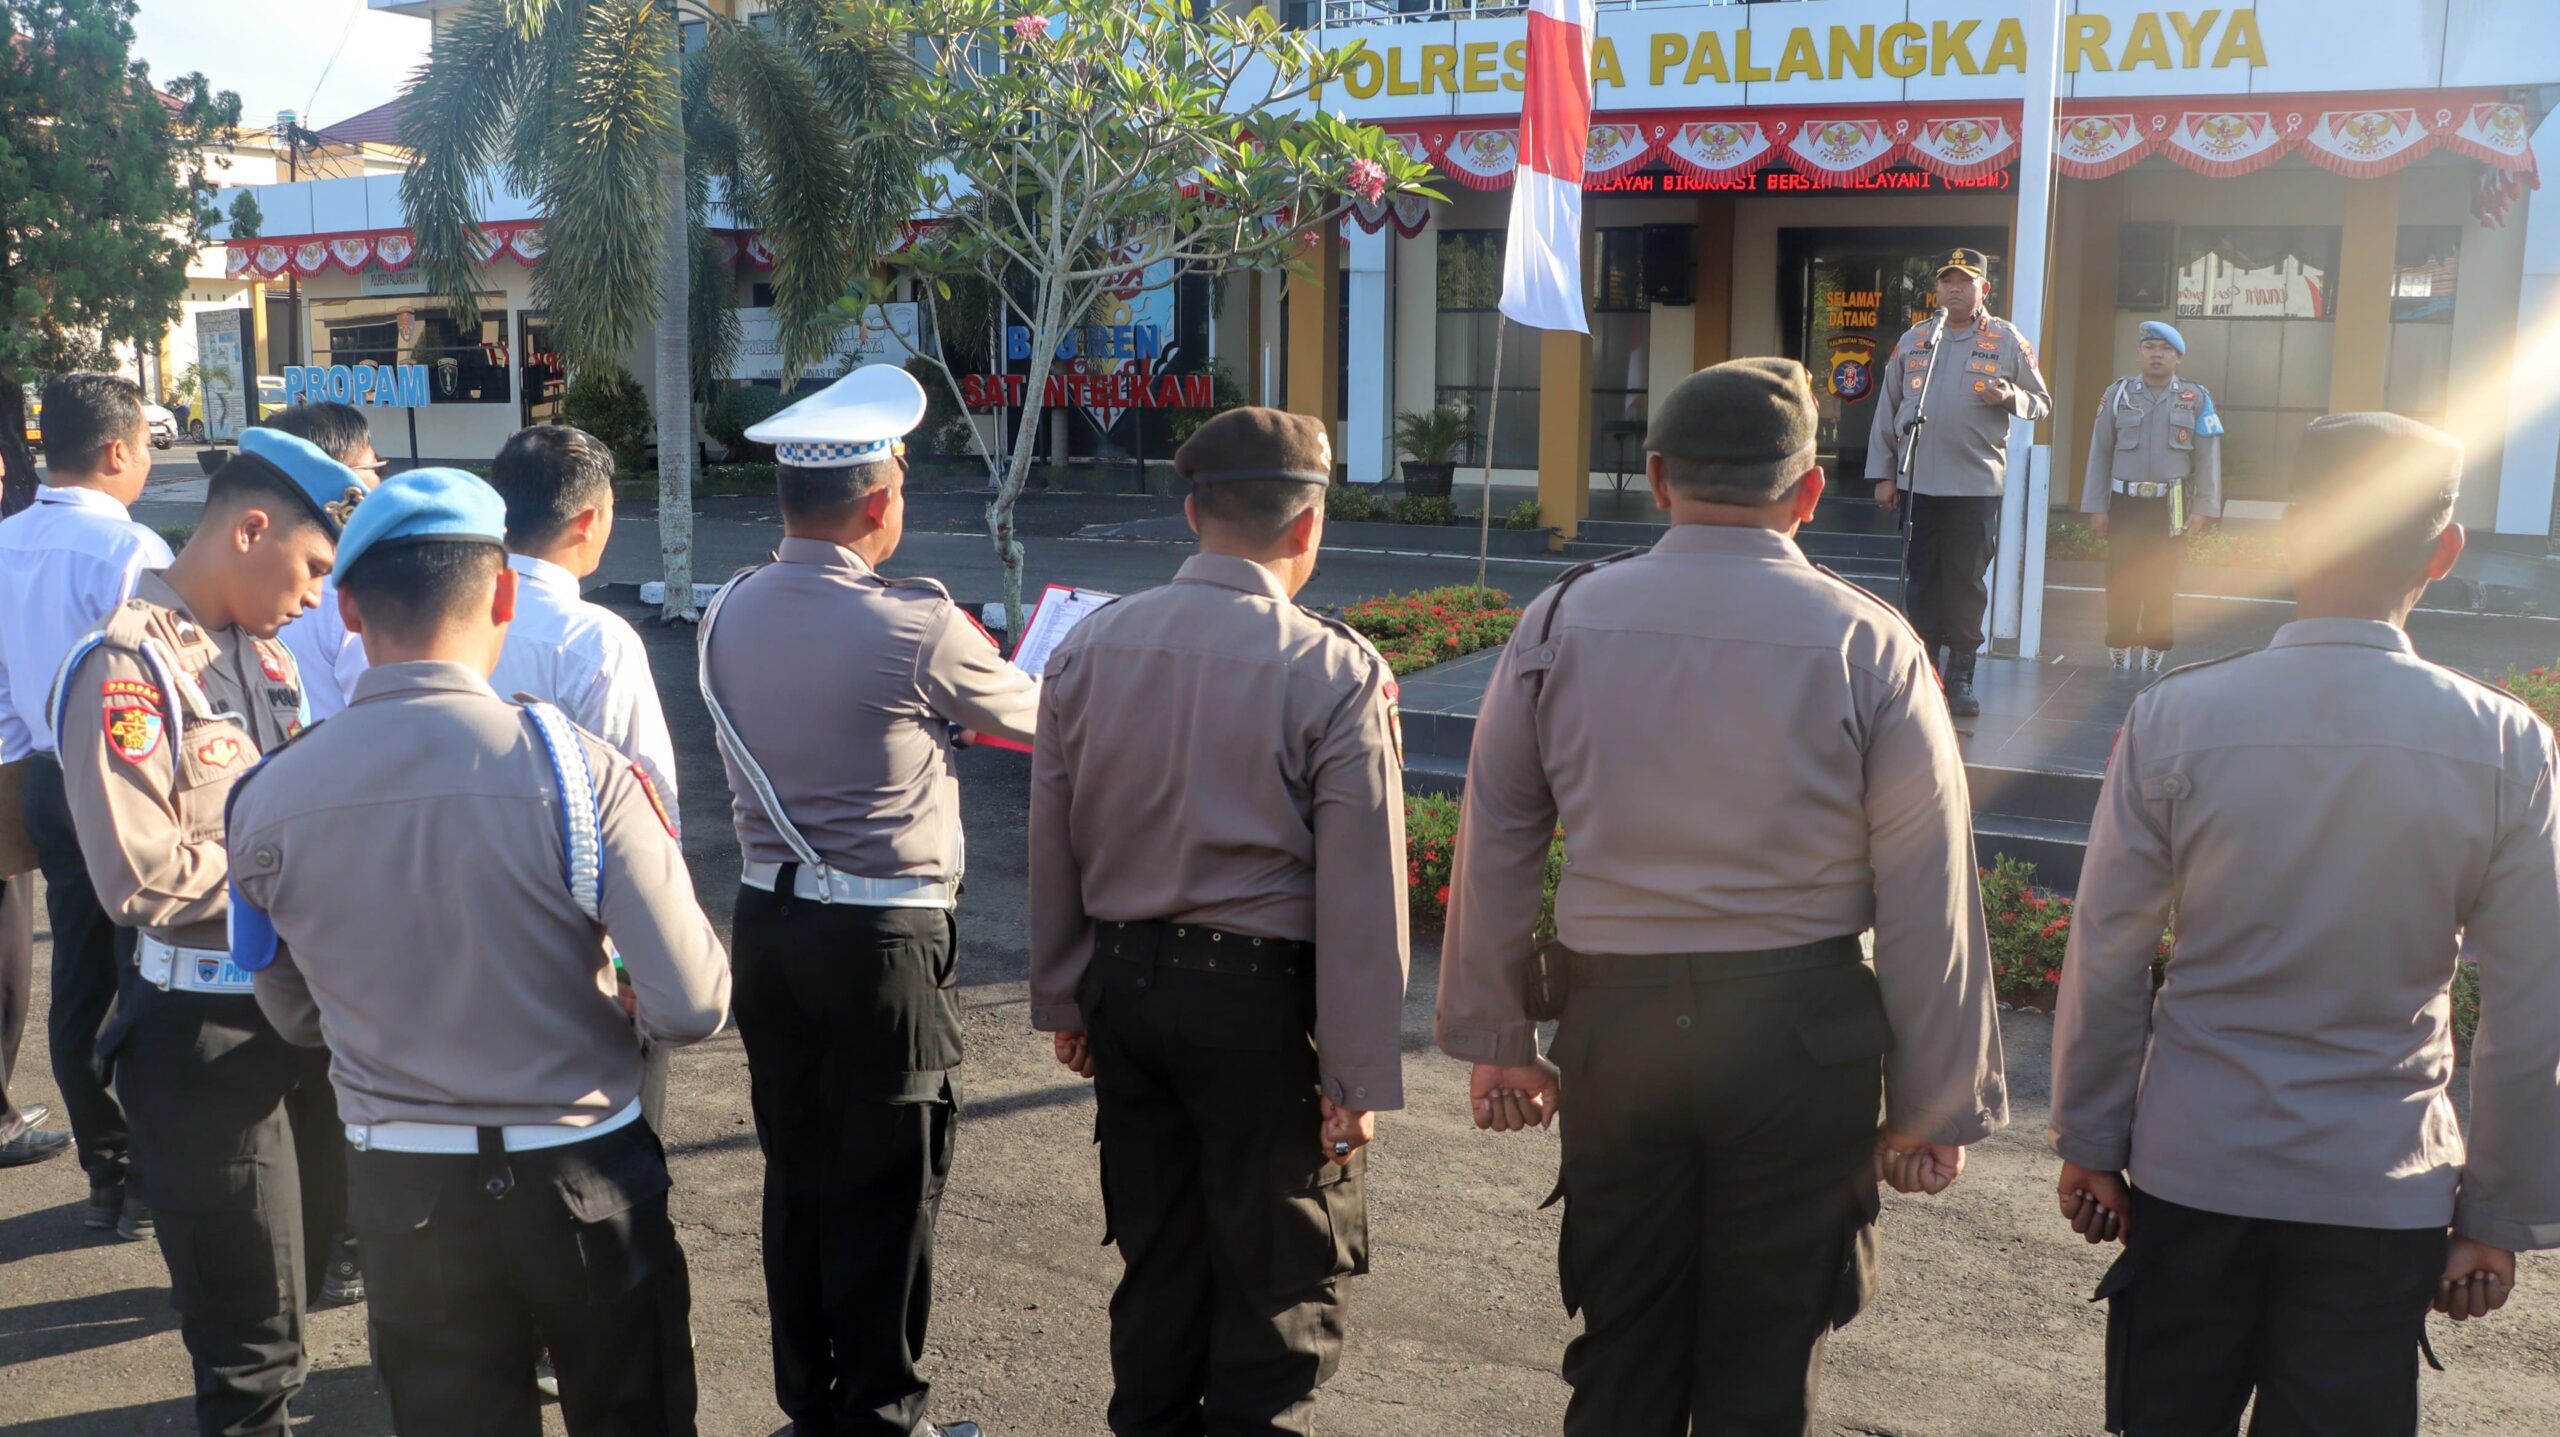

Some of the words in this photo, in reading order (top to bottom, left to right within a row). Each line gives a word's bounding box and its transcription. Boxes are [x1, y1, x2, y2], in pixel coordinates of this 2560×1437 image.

[1308, 40, 1626, 100] POLRESA
[1650, 18, 2027, 85] PALANGKA
[2063, 9, 2268, 72] RAYA
[1767, 173, 1833, 190] BERSI
[1843, 172, 1930, 189] ELAYANI
[1826, 291, 1882, 308] SELAMAT
[1829, 310, 1877, 327] DATANG
[741, 343, 785, 355] POLREST
[1007, 325, 1078, 359] BG
[1971, 350, 1999, 361] POLRI
[284, 364, 431, 408] PROPAM
[962, 375, 1026, 407] SAT
[1043, 375, 1214, 409] NTELKAM
[107, 682, 161, 702] PROPAM
